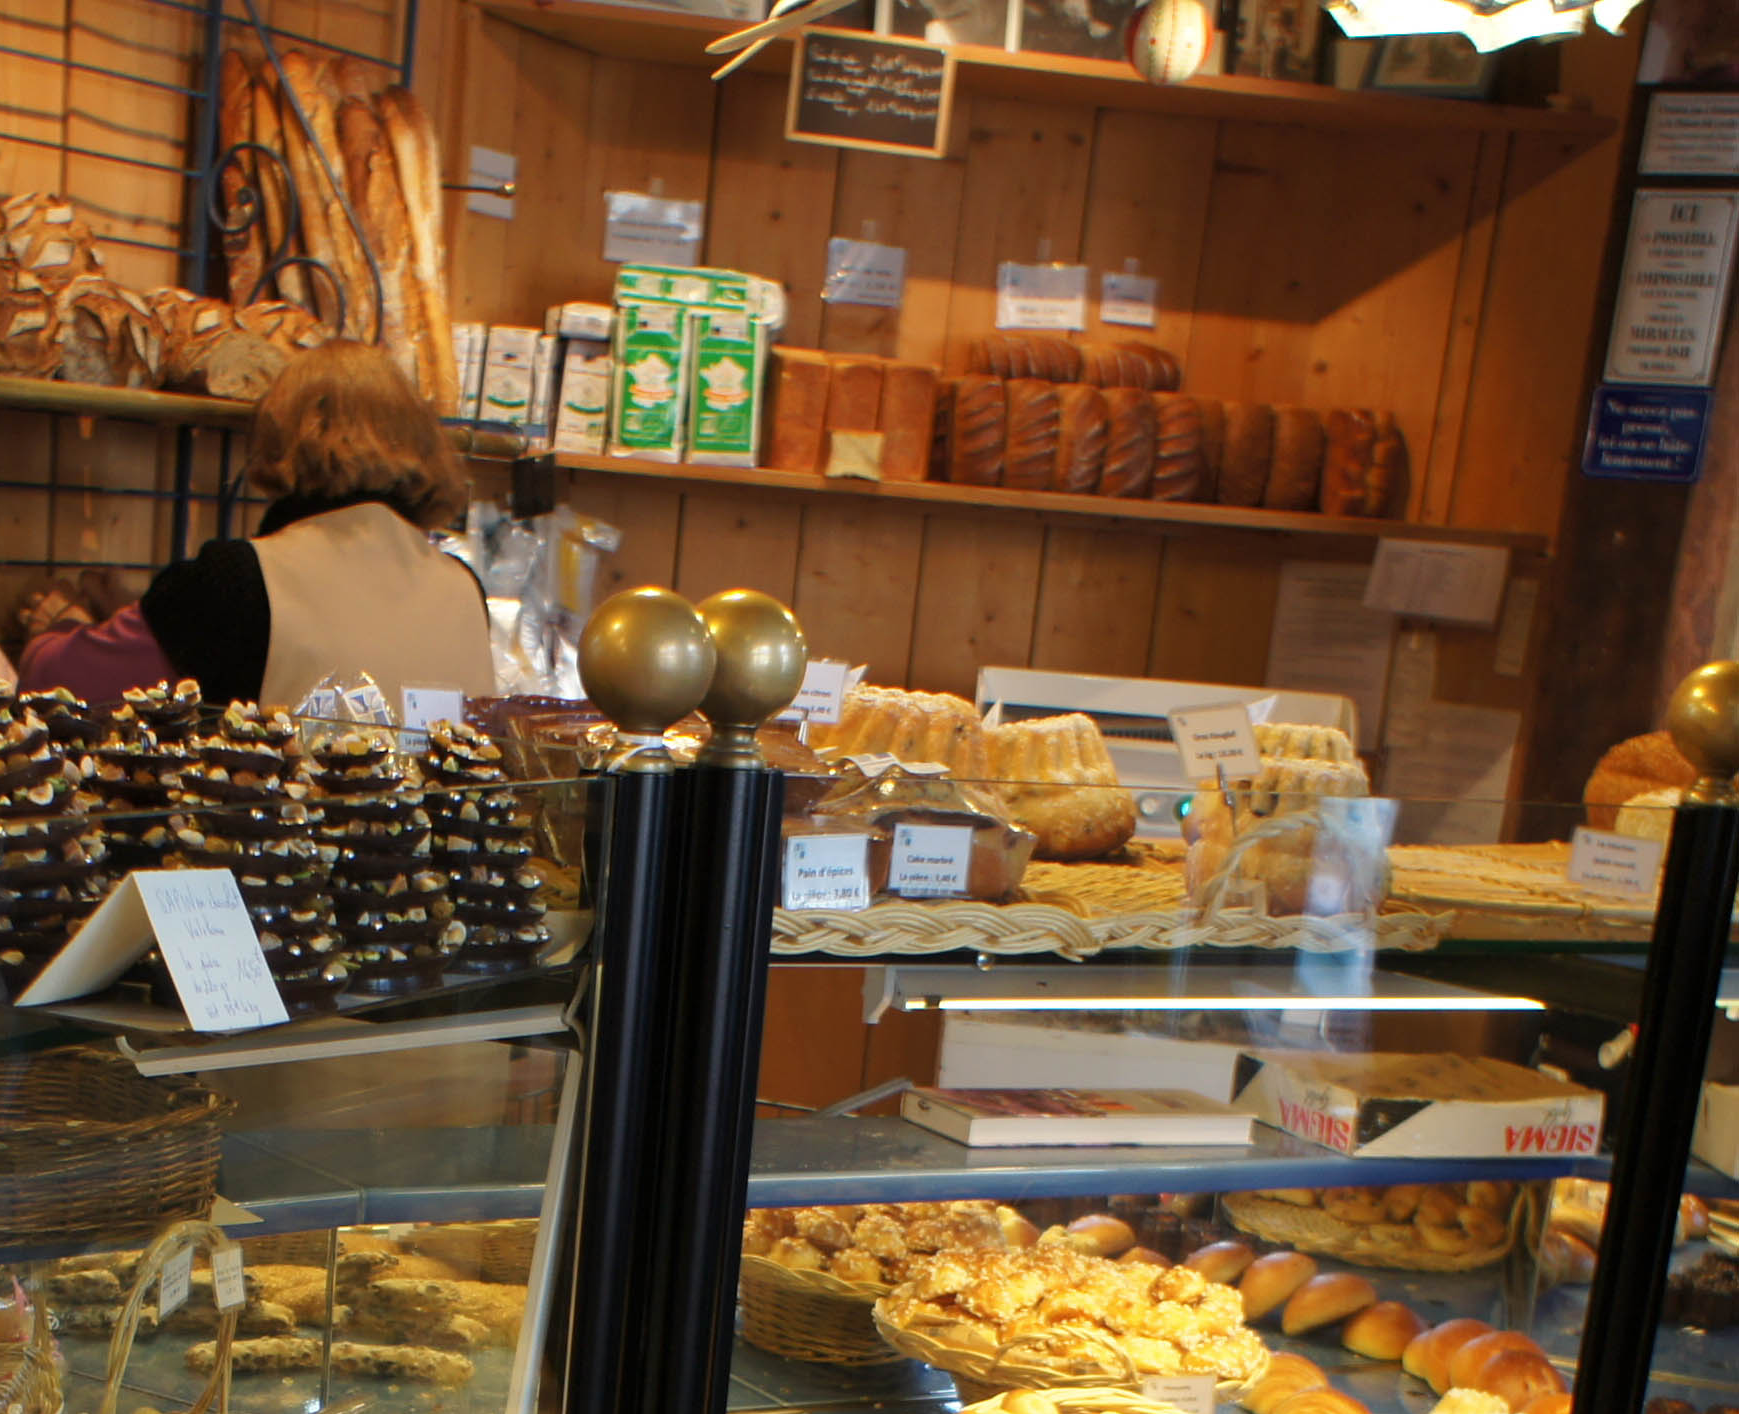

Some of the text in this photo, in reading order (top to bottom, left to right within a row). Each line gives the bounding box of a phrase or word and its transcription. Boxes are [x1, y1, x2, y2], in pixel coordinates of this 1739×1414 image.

[798, 867, 817, 880] Pain
[1278, 1098, 1352, 1151] SIGMA
[1504, 1125, 1597, 1154] SIGMA
